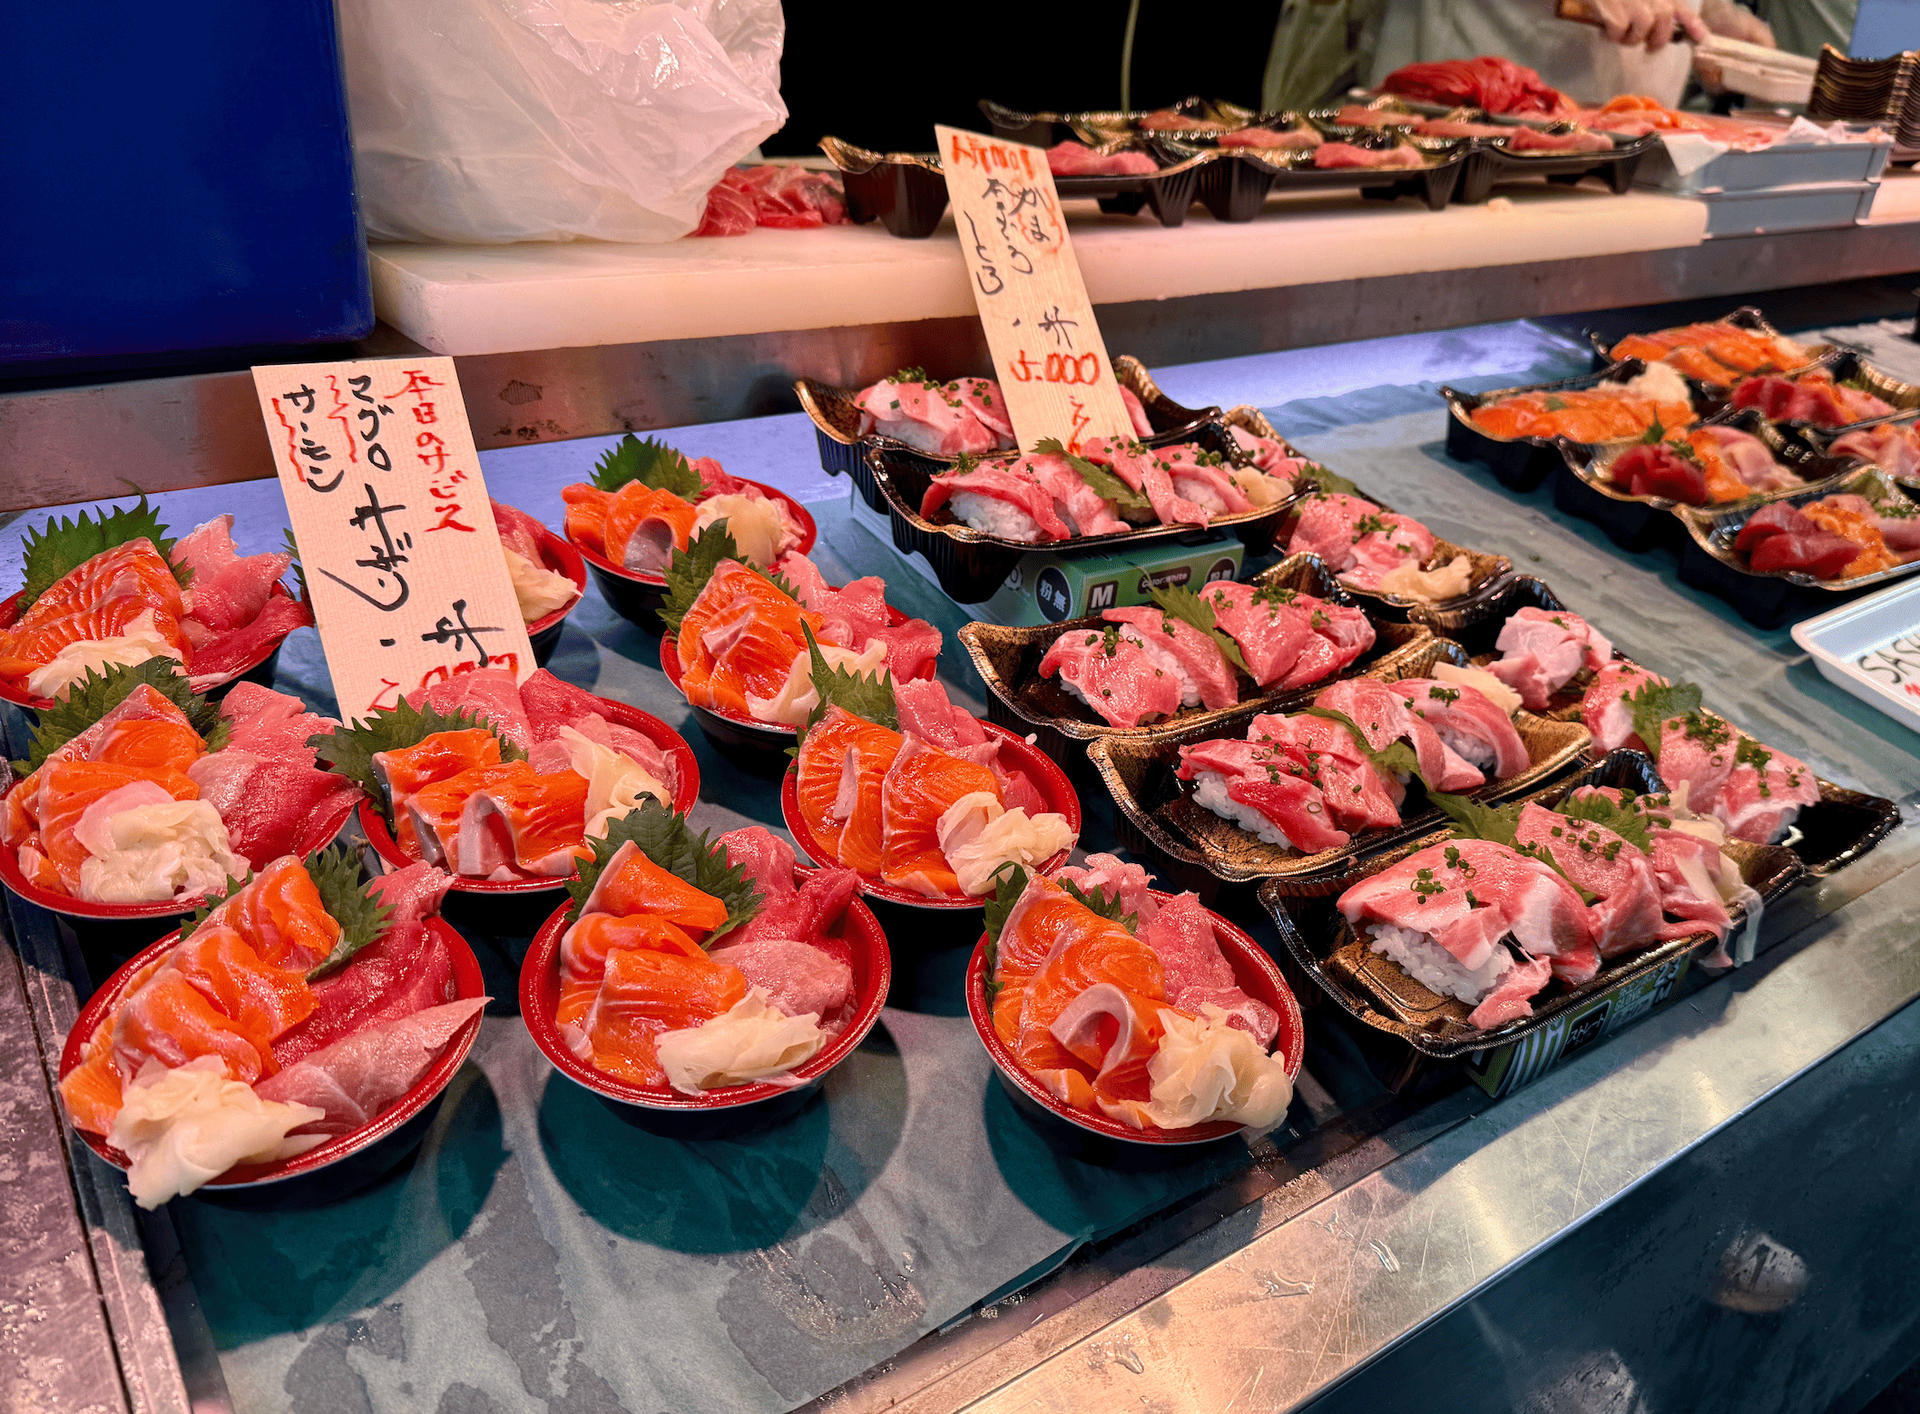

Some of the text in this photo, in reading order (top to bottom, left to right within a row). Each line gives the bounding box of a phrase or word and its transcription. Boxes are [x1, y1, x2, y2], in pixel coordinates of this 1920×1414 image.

[283, 383, 345, 494] サーモン
[1091, 584, 1114, 609] M
